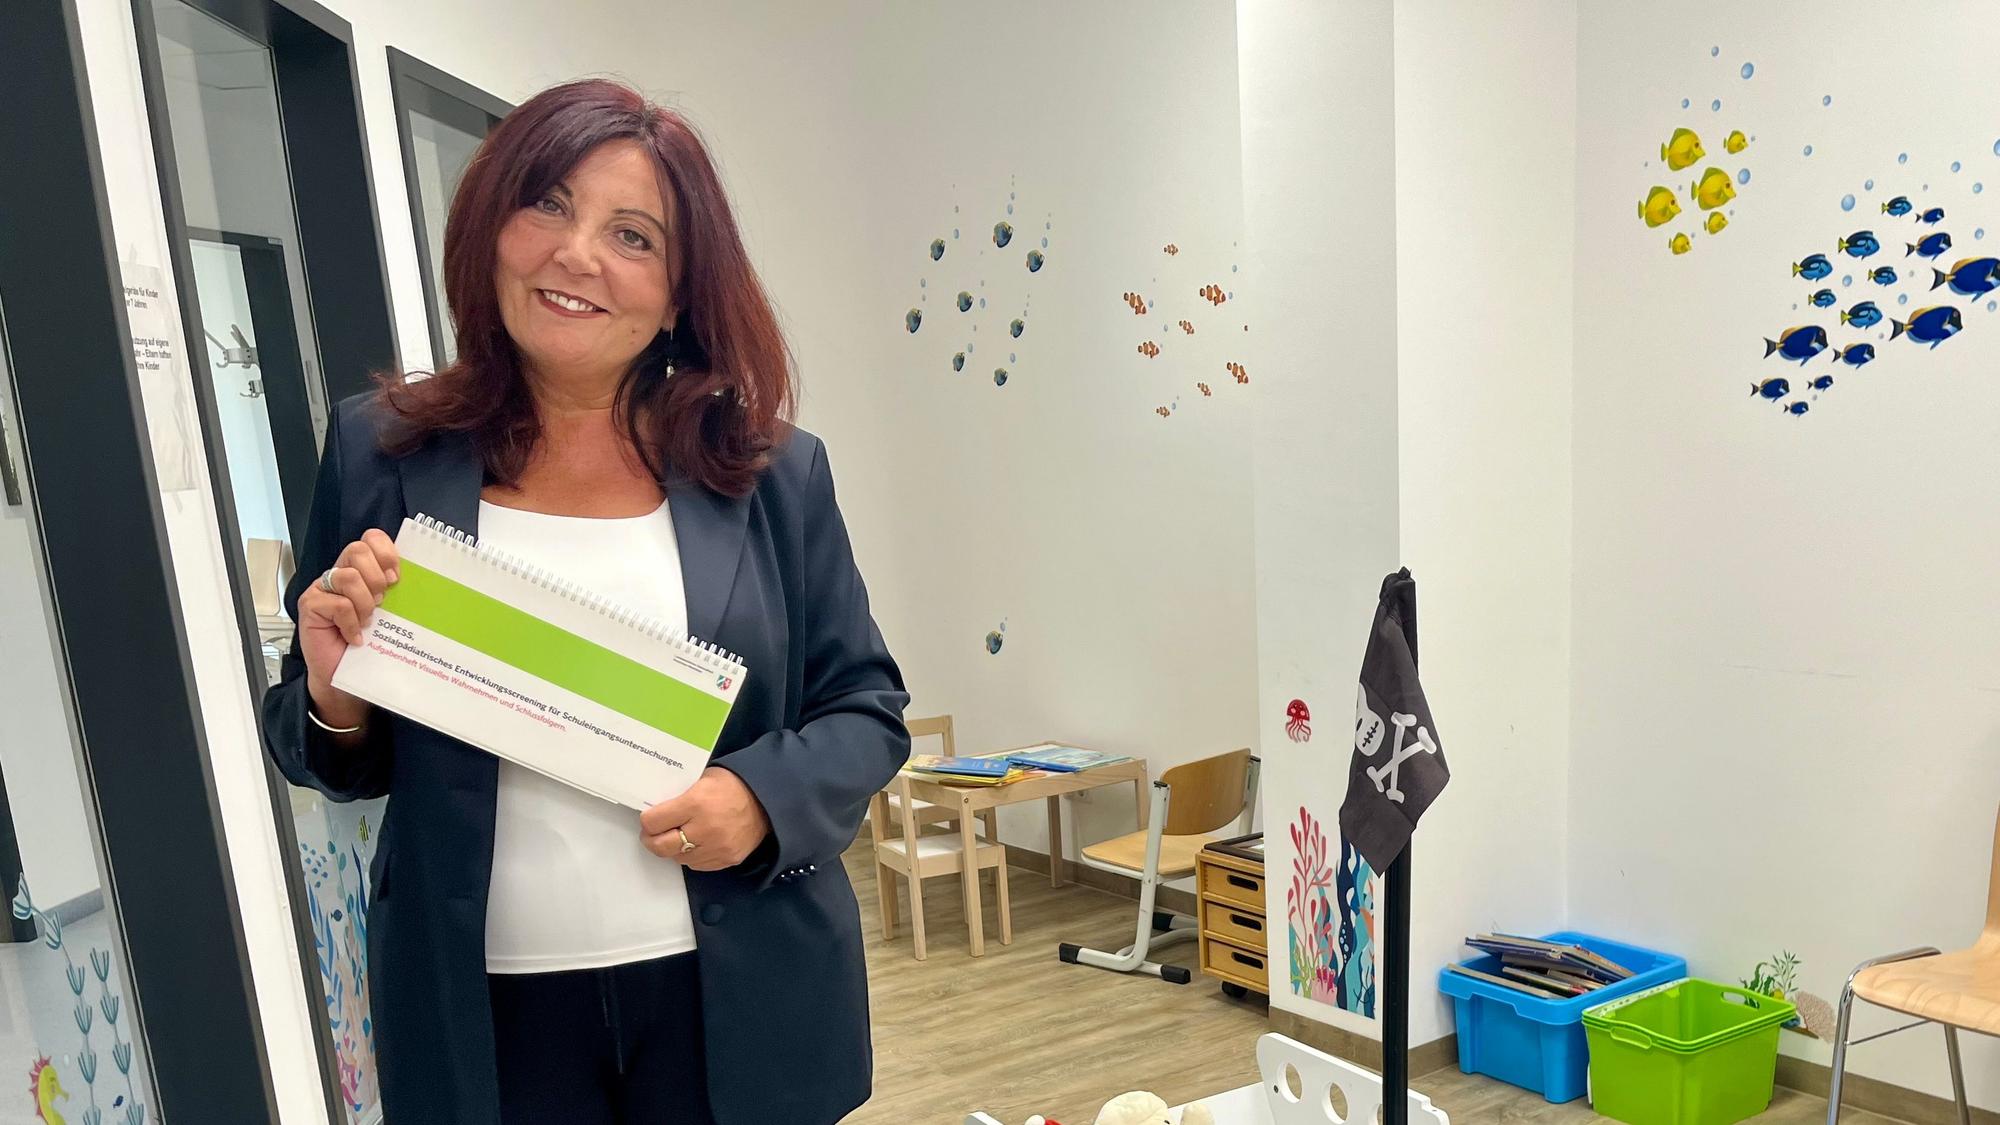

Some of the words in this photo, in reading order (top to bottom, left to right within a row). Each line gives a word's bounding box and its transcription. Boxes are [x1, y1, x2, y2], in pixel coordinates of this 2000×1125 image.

[145, 288, 159, 298] Kinder
[377, 618, 415, 641] SOPESS.
[367, 641, 418, 668] Aufgabenheft
[418, 662, 450, 682] Visuelles
[451, 676, 499, 703] Wahrnehmen
[500, 697, 514, 710] und
[515, 704, 567, 733] Schlussfolgern.
[372, 629, 453, 670] Sozialpädiatrisches
[454, 665, 547, 712] Entwicklungsscreening
[547, 705, 561, 717] für
[562, 711, 685, 770] Schuleingangsuntersuchungen.
